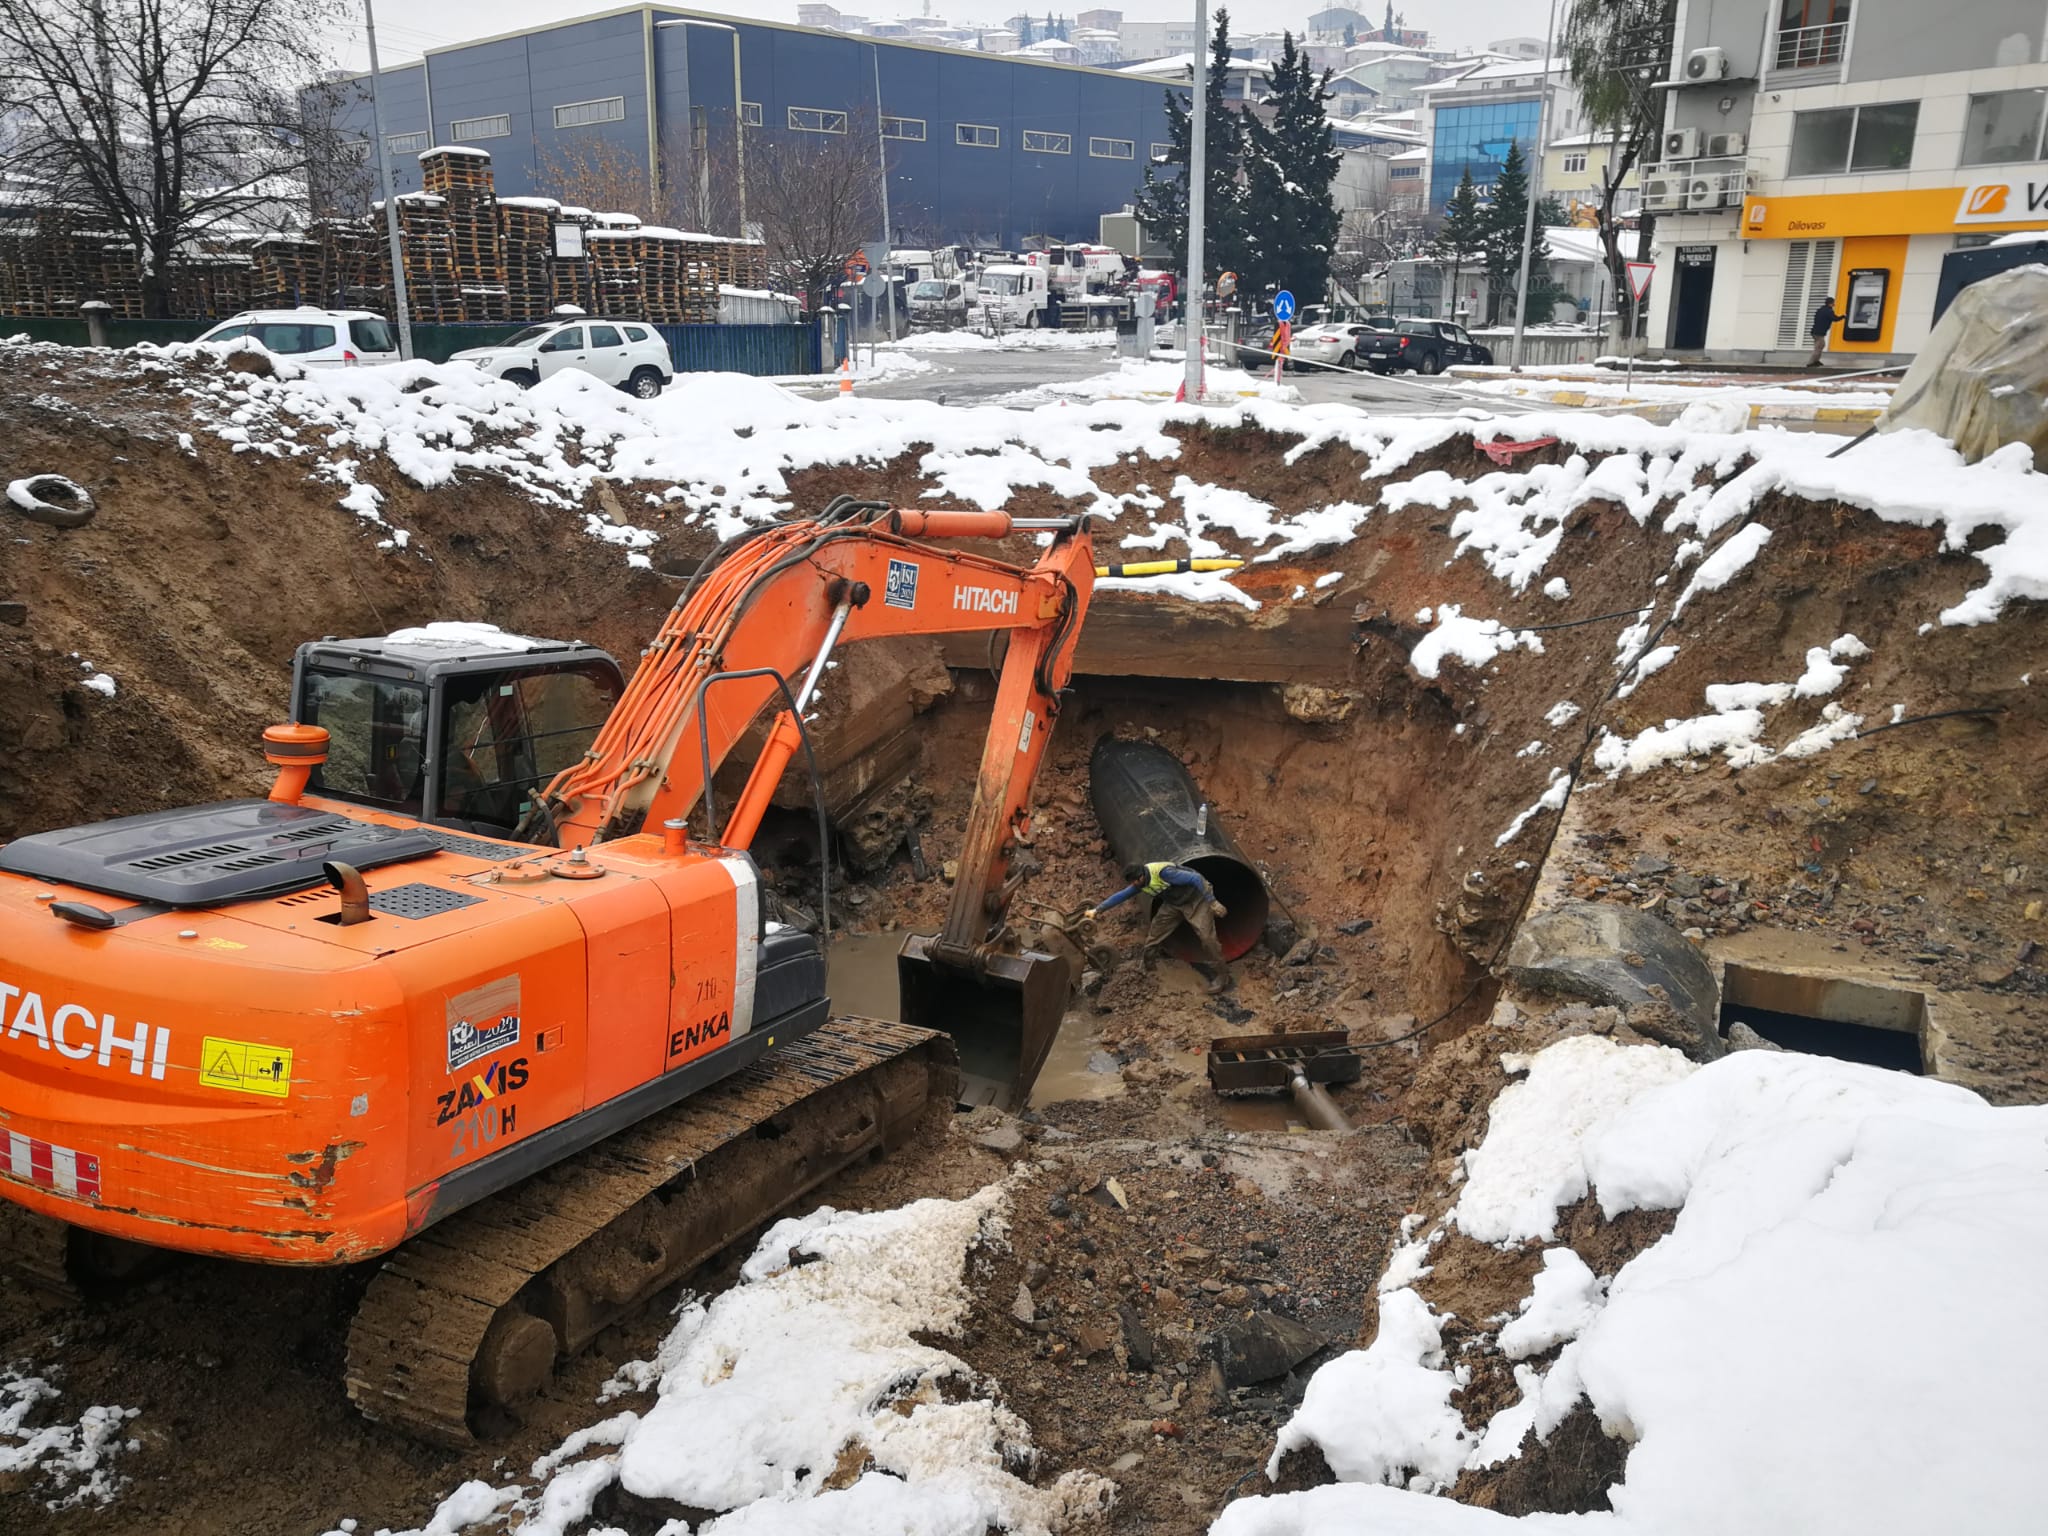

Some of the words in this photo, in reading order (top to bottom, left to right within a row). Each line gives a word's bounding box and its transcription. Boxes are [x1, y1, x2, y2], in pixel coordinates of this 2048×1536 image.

[953, 585, 1018, 614] HITACHI
[669, 1010, 729, 1057] ENKA
[437, 1058, 528, 1127] ZAXIS
